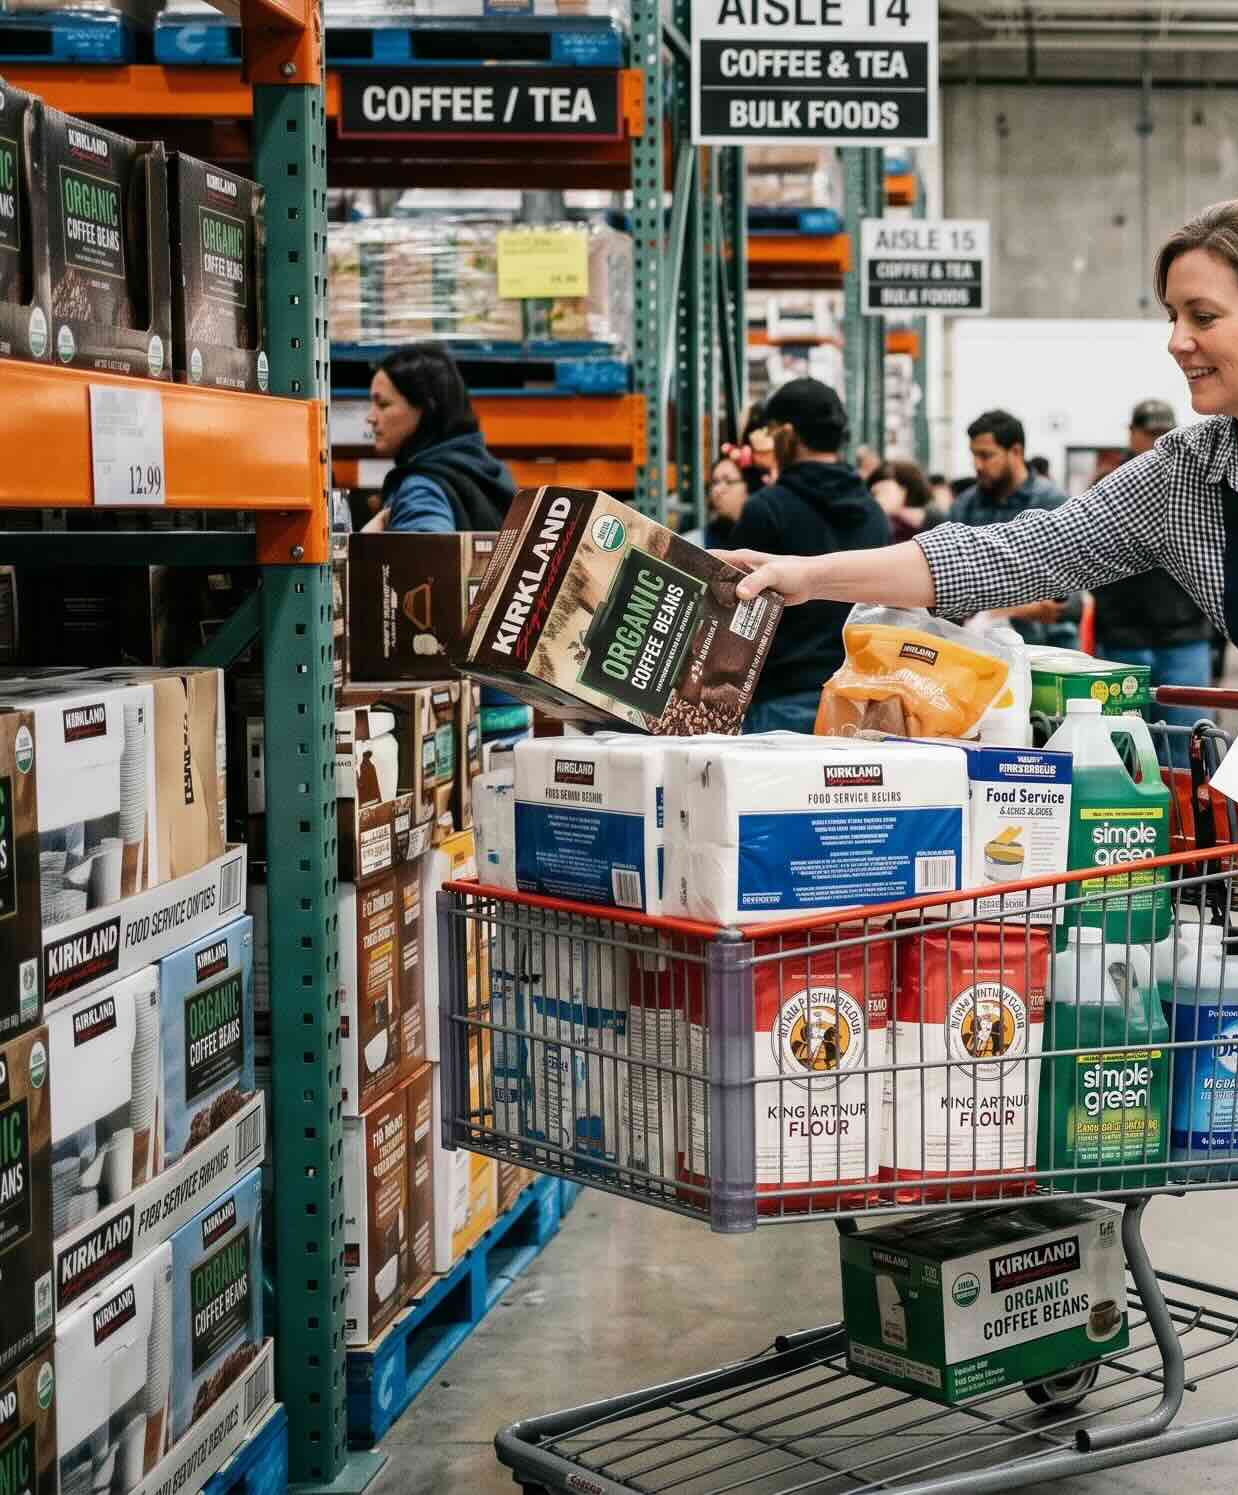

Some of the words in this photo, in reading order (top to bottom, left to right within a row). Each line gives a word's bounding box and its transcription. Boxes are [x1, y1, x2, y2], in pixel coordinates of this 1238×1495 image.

[718, 0, 843, 26] AISLE
[867, 0, 910, 27] 14
[719, 49, 822, 78] COFFEE
[827, 51, 849, 78] &
[854, 51, 909, 78] TEA
[362, 85, 494, 122] COFFEE
[503, 87, 519, 122] /
[528, 87, 597, 122] TEA
[729, 99, 802, 128] BULK
[808, 101, 900, 129] FOODS
[64, 176, 119, 226] ORGANIC
[66, 217, 97, 246] COFFEE
[875, 228, 938, 251] AISLE
[951, 229, 976, 251] 15
[129, 465, 162, 495] 12.99
[491, 496, 572, 655] KIRKLAND
[601, 568, 665, 681] ORGANIC
[631, 634, 665, 690] COFFEE
[652, 583, 685, 635] BEANS
[826, 766, 881, 779] KIRKLAND
[808, 792, 831, 804] FOOD
[833, 791, 868, 804] SERVICE
[986, 788, 1015, 803] Food
[1019, 789, 1065, 804] Service
[1092, 821, 1157, 848] simple
[1094, 848, 1155, 866] green
[48, 924, 118, 977] KIRKLAND
[125, 916, 150, 949] FOOD
[151, 898, 186, 938] SERVICE
[189, 980, 240, 1040] ORGANIC
[190, 1035, 218, 1067] COFFEE
[1083, 1062, 1154, 1091] simple
[767, 1105, 805, 1119] KNG
[1084, 1088, 1147, 1116] green
[788, 1119, 849, 1137] FLOUR
[959, 1110, 1015, 1127] FLOUR
[0, 1163, 24, 1204] ANS
[61, 1215, 132, 1284] KIRKLAND
[993, 1240, 1077, 1279] KIRKLAND
[194, 1298, 224, 1337] COFFEE
[224, 1272, 248, 1310] BEANS
[1004, 1278, 1070, 1313] ORGANIC
[983, 1307, 1039, 1342] COFFEE
[1043, 1293, 1090, 1323] BEANS
